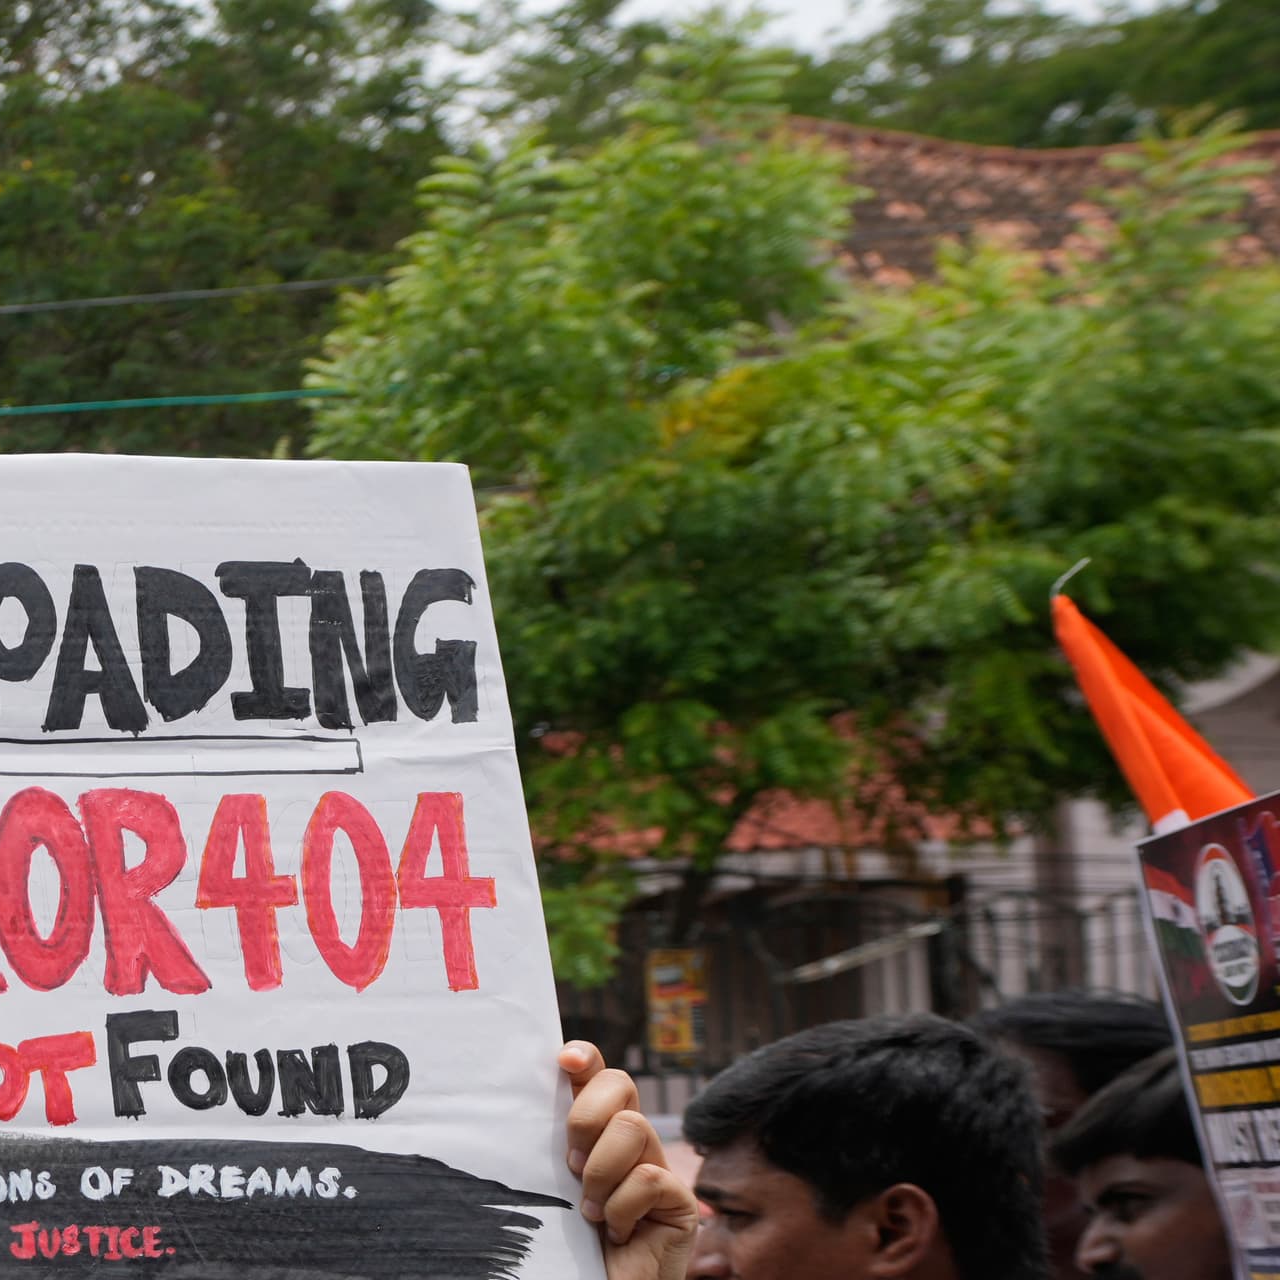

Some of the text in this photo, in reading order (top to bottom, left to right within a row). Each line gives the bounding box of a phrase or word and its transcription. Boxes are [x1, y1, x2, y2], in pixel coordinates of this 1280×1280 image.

[195, 791, 496, 992] 404
[80, 1165, 135, 1201] OF
[157, 1163, 359, 1199] DREAMS.
[9, 1220, 176, 1260] JUSTICE.
